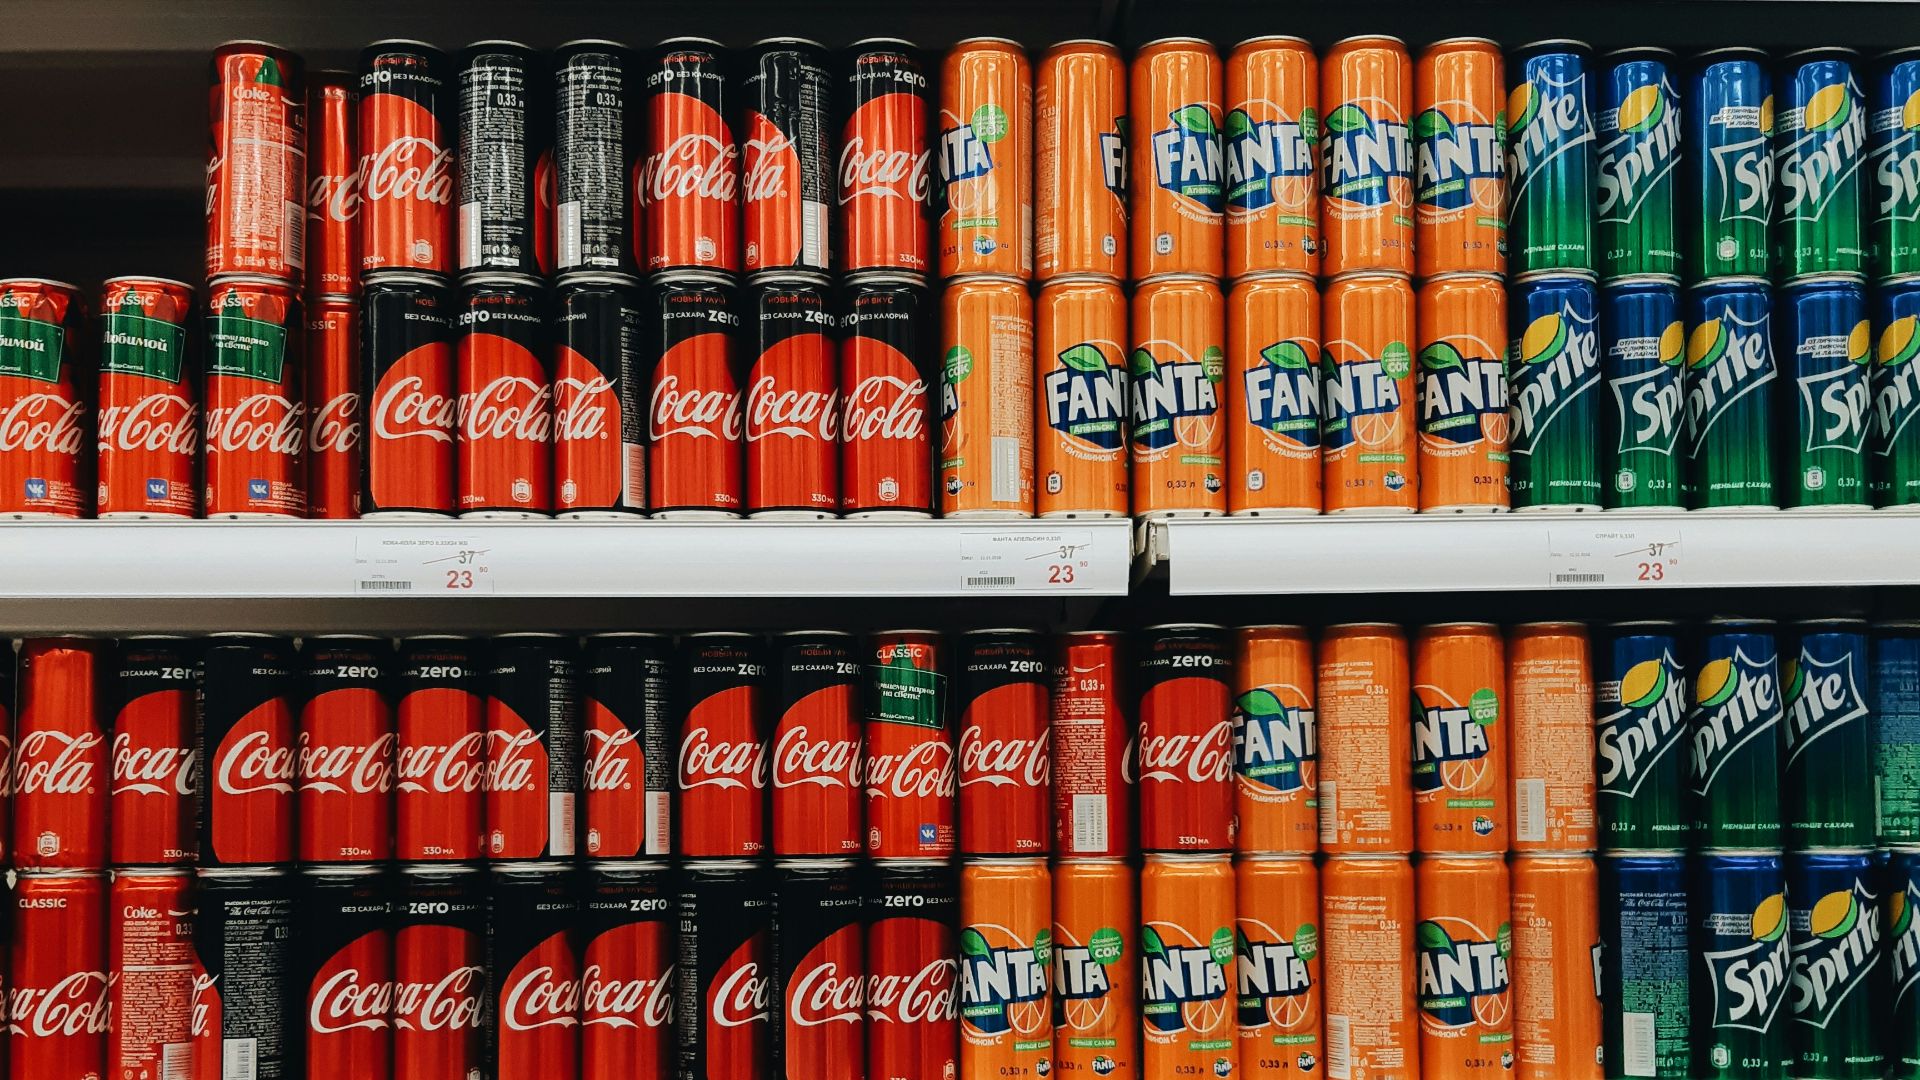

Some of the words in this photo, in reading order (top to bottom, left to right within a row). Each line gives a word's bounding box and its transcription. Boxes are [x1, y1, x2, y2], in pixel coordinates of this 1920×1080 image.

[361, 70, 390, 88] zero
[392, 72, 407, 80] БЕЗ
[647, 69, 674, 88] zero
[676, 70, 690, 78] БЕЗ
[862, 71, 890, 79] САХАРА
[894, 69, 926, 87] zero
[497, 92, 517, 106] 0,33
[596, 92, 615, 105] 0,33
[1417, 124, 1505, 187] ANTA
[1523, 245, 1556, 254] МЕНЬШЕ
[1558, 243, 1584, 251] САХАРА
[900, 253, 915, 263] 330
[106, 295, 154, 307] CLASSIC
[210, 296, 254, 308] CLASSIC
[460, 310, 490, 326] zero
[492, 312, 506, 320] БЕЗ
[708, 309, 739, 326] zero
[805, 310, 834, 326] zero
[873, 312, 908, 320] КАЛОРИЙ
[948, 363, 969, 377] СОК
[1388, 362, 1408, 373] СОК
[1687, 328, 1766, 441] prite
[1132, 365, 1217, 425] ANTA
[1245, 367, 1321, 422] FAN
[1073, 423, 1115, 434] Апельсин
[1428, 417, 1472, 431] Апельсин
[1066, 447, 1112, 462] ВИТАМИНОМ
[1167, 480, 1186, 490] 0,33
[1474, 476, 1492, 484] 0,33
[1648, 479, 1666, 489] 0,33
[1710, 482, 1744, 490] МЕНЬШЕ
[1745, 481, 1771, 489] САХАРА
[1838, 477, 1854, 487] 0,33
[714, 494, 730, 503] 330
[811, 494, 827, 503] 330
[1060, 545, 1075, 560] 37
[1649, 543, 1664, 557] 37
[459, 551, 475, 564] 37
[1048, 565, 1074, 584] 23
[1638, 562, 1664, 581] 23
[446, 570, 474, 589] 23
[876, 647, 922, 658] CLASSIC
[1010, 660, 1043, 673] zero
[1172, 655, 1213, 668] zero
[337, 665, 378, 678] zero
[420, 666, 462, 678] zero
[1080, 680, 1098, 692] 0,33
[1366, 685, 1383, 695] 0,33
[1475, 708, 1497, 720] СОК
[1415, 709, 1488, 761] NTA
[1249, 764, 1294, 776] Апельсин
[1472, 820, 1494, 831] FANTA
[1611, 822, 1628, 832] 0,33
[1722, 822, 1756, 830] МЕНЬШЕ
[743, 842, 758, 850] 330
[1016, 840, 1032, 848] 330
[1178, 836, 1196, 844] 330
[163, 849, 182, 858] 330
[340, 847, 359, 855] 330
[423, 846, 440, 854] 330
[18, 899, 67, 908] CLASSIC
[630, 899, 667, 911] zero
[884, 895, 924, 907] zero
[409, 901, 449, 914] zero
[1380, 919, 1397, 929] 0,33
[1528, 917, 1546, 927] 0,33
[175, 922, 192, 935] 0,33
[1094, 946, 1120, 958] СОК
[1216, 947, 1233, 958] СОК
[1298, 943, 1318, 954] СОК
[1143, 949, 1226, 999] ANTA
[1238, 945, 1309, 995] NTA
[1421, 944, 1509, 995] ANTA
[1465, 1058, 1485, 1068] 0,33
[1742, 1058, 1760, 1068] 0,33
[1803, 1053, 1820, 1062] 0,33
[1092, 1058, 1116, 1071] FANTA
[1176, 1065, 1195, 1074] 0,33
[1260, 1059, 1279, 1069] 0,33
[1000, 1065, 1020, 1076] 0,33
